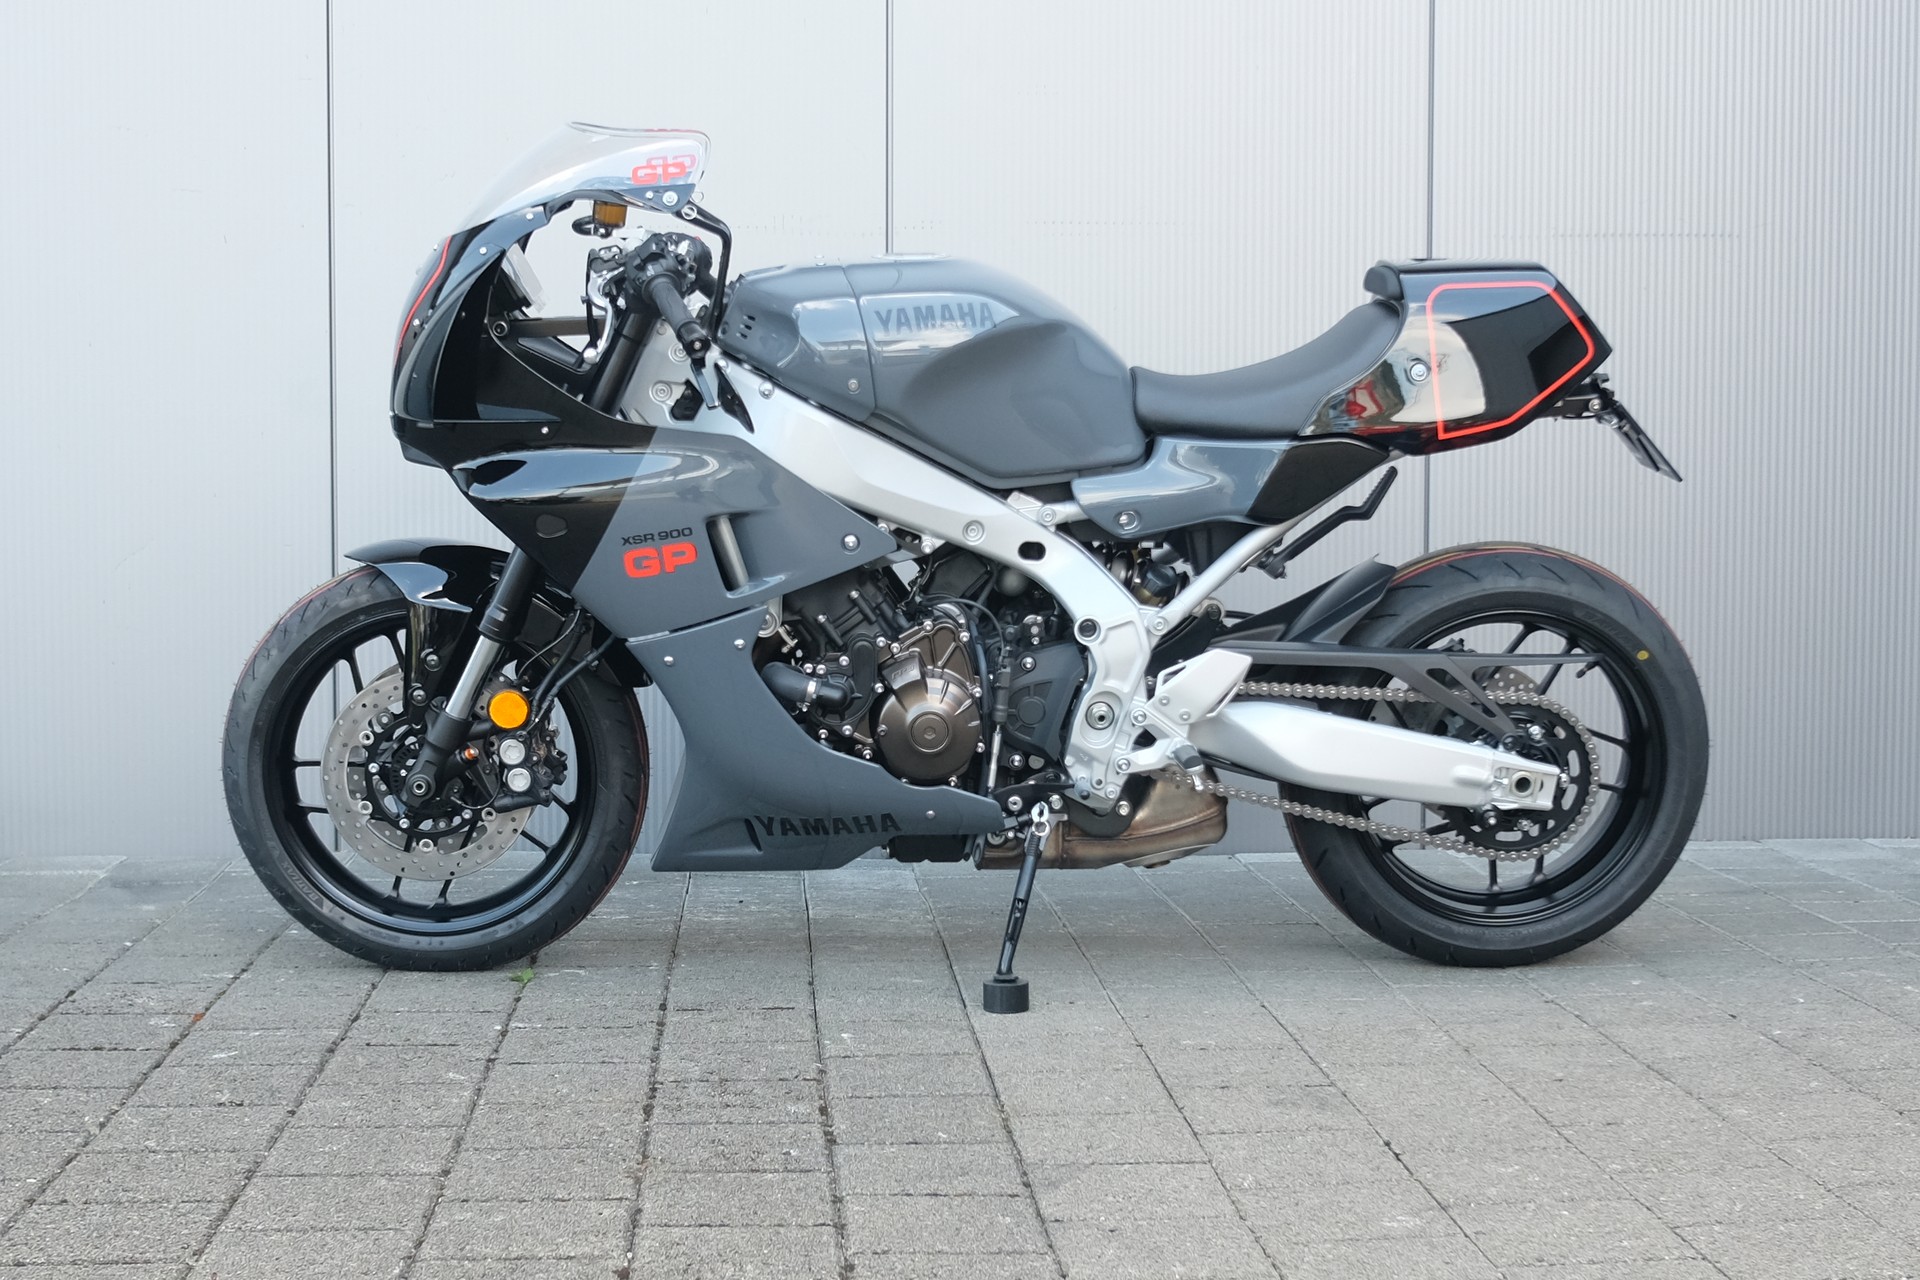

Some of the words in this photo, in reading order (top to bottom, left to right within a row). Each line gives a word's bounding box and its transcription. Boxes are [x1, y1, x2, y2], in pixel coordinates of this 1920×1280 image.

[632, 162, 686, 185] GP
[874, 302, 996, 336] YAMAHA
[621, 533, 655, 546] XSR
[658, 527, 693, 540] 900
[623, 542, 698, 578] GP
[754, 812, 902, 836] YAMAHA
